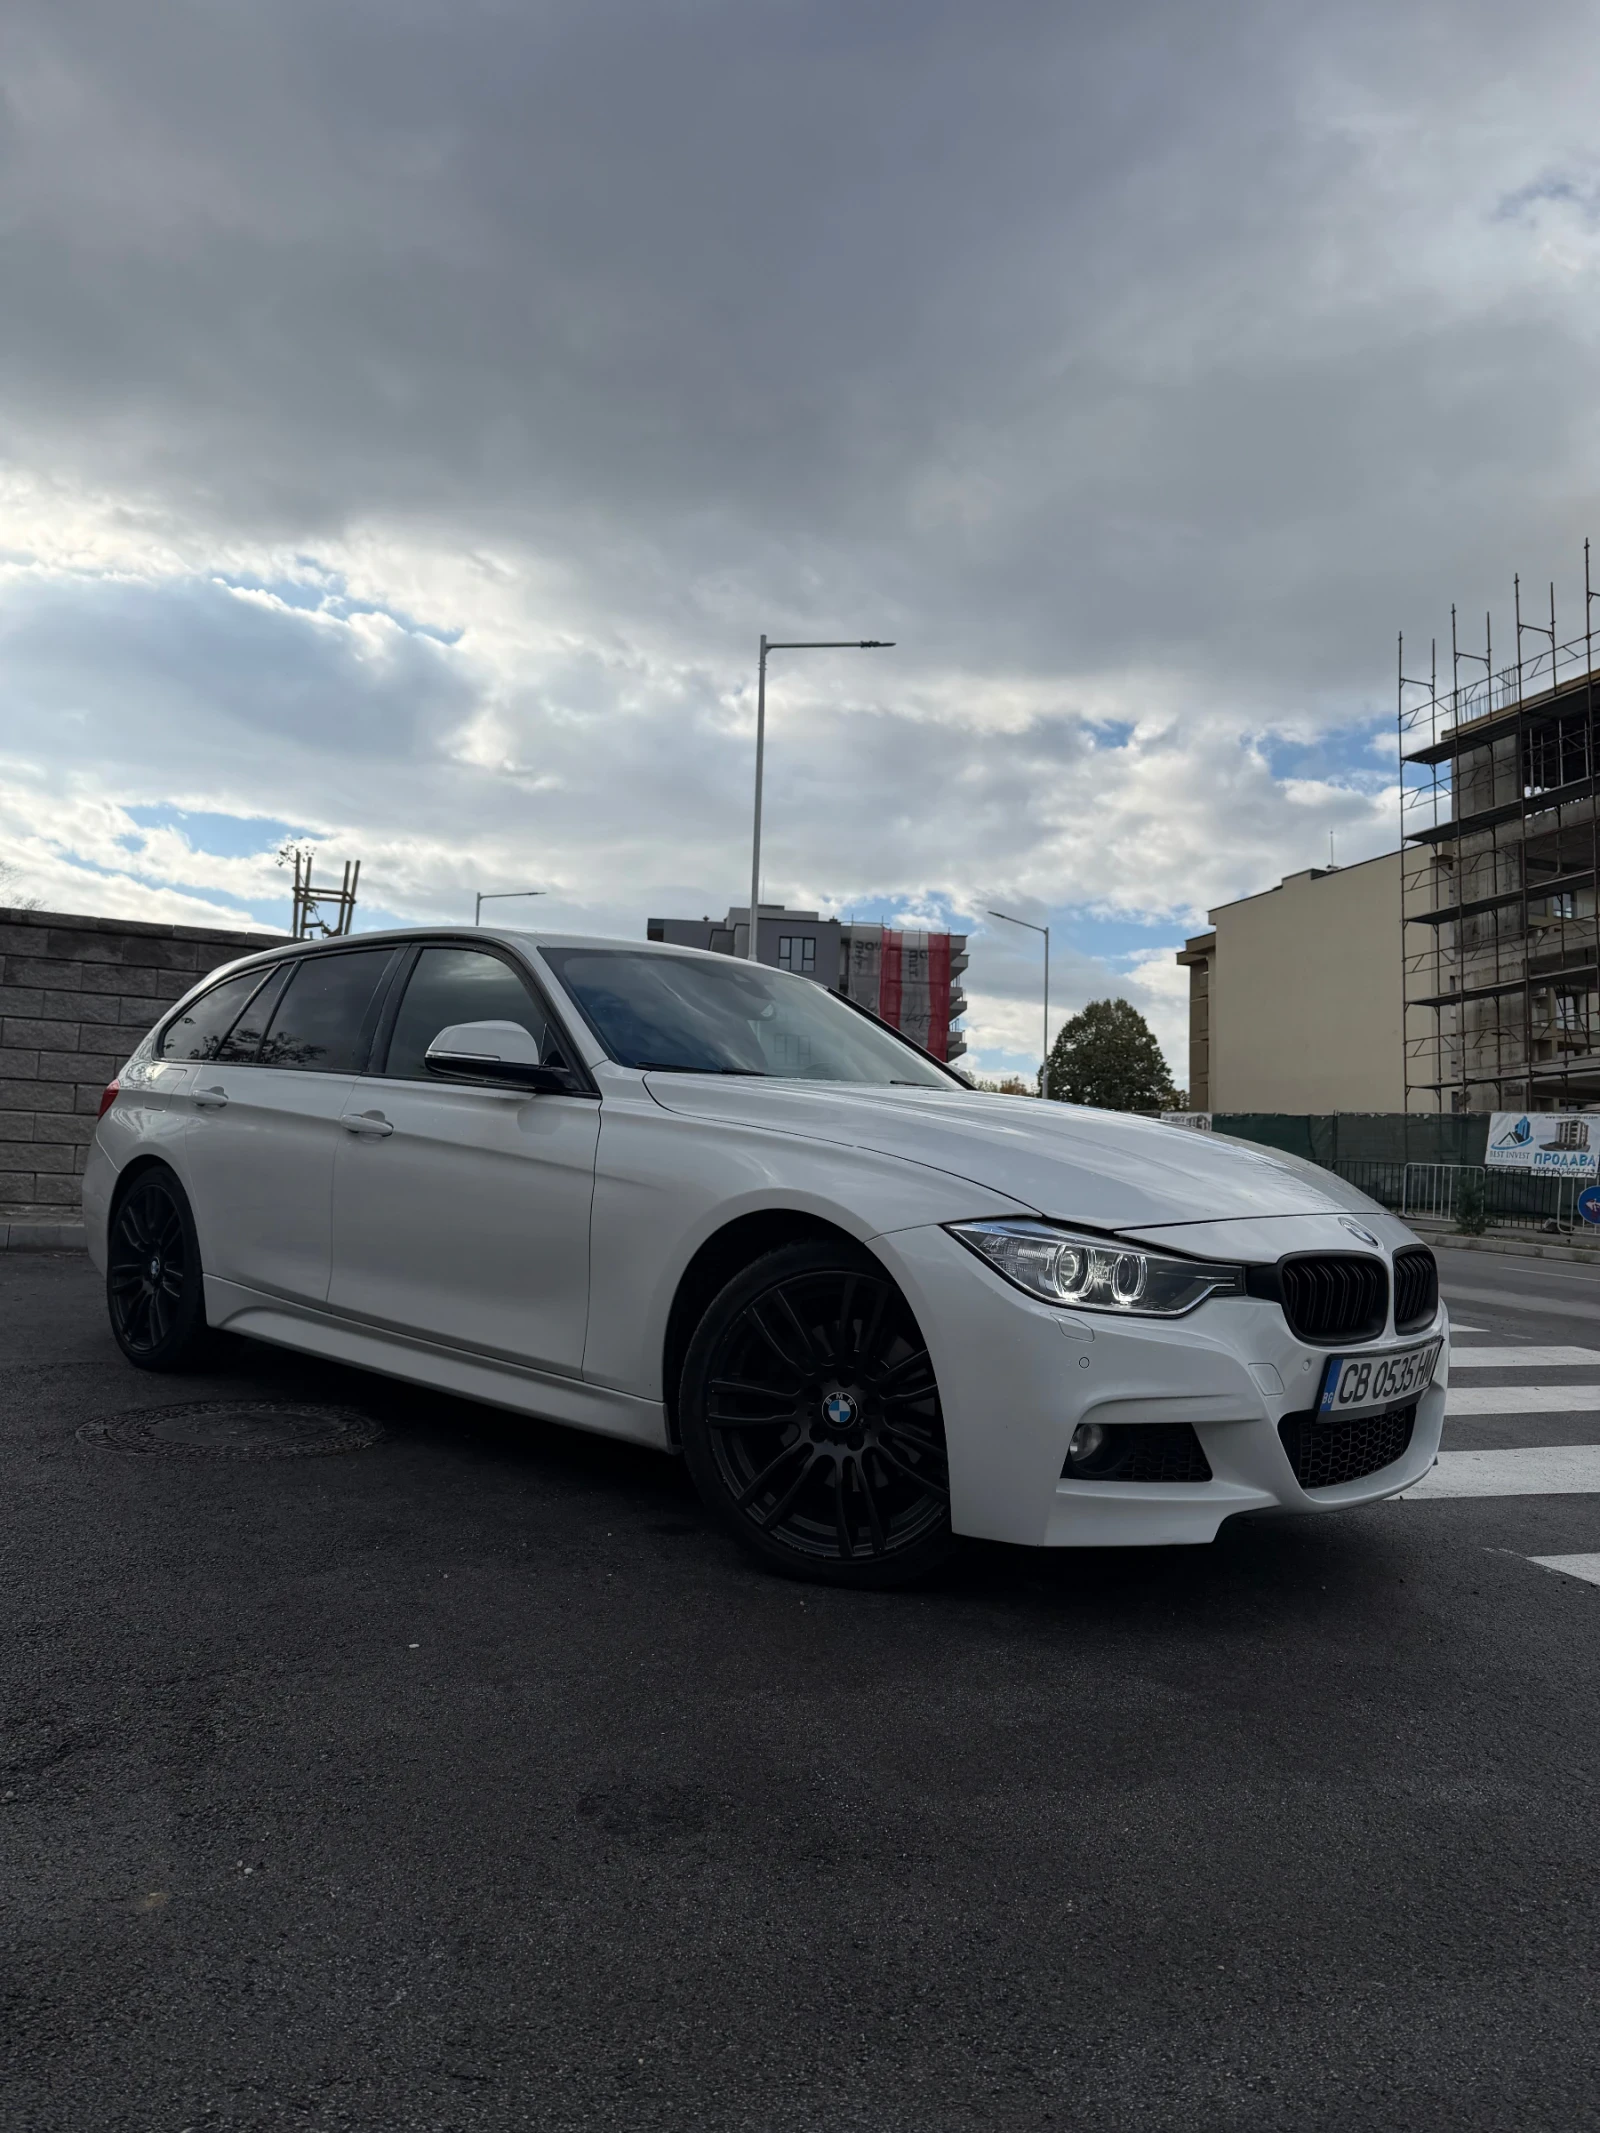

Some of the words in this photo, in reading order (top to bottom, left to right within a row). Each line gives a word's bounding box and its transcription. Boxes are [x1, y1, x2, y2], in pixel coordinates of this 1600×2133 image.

[1506, 1151, 1531, 1159] INVEST
[1534, 1152, 1596, 1167] ПРОДАВА
[1338, 1362, 1372, 1404] CB
[1373, 1354, 1419, 1399] 0535
[825, 1392, 854, 1406] BMW
[1321, 1392, 1334, 1404] BG
